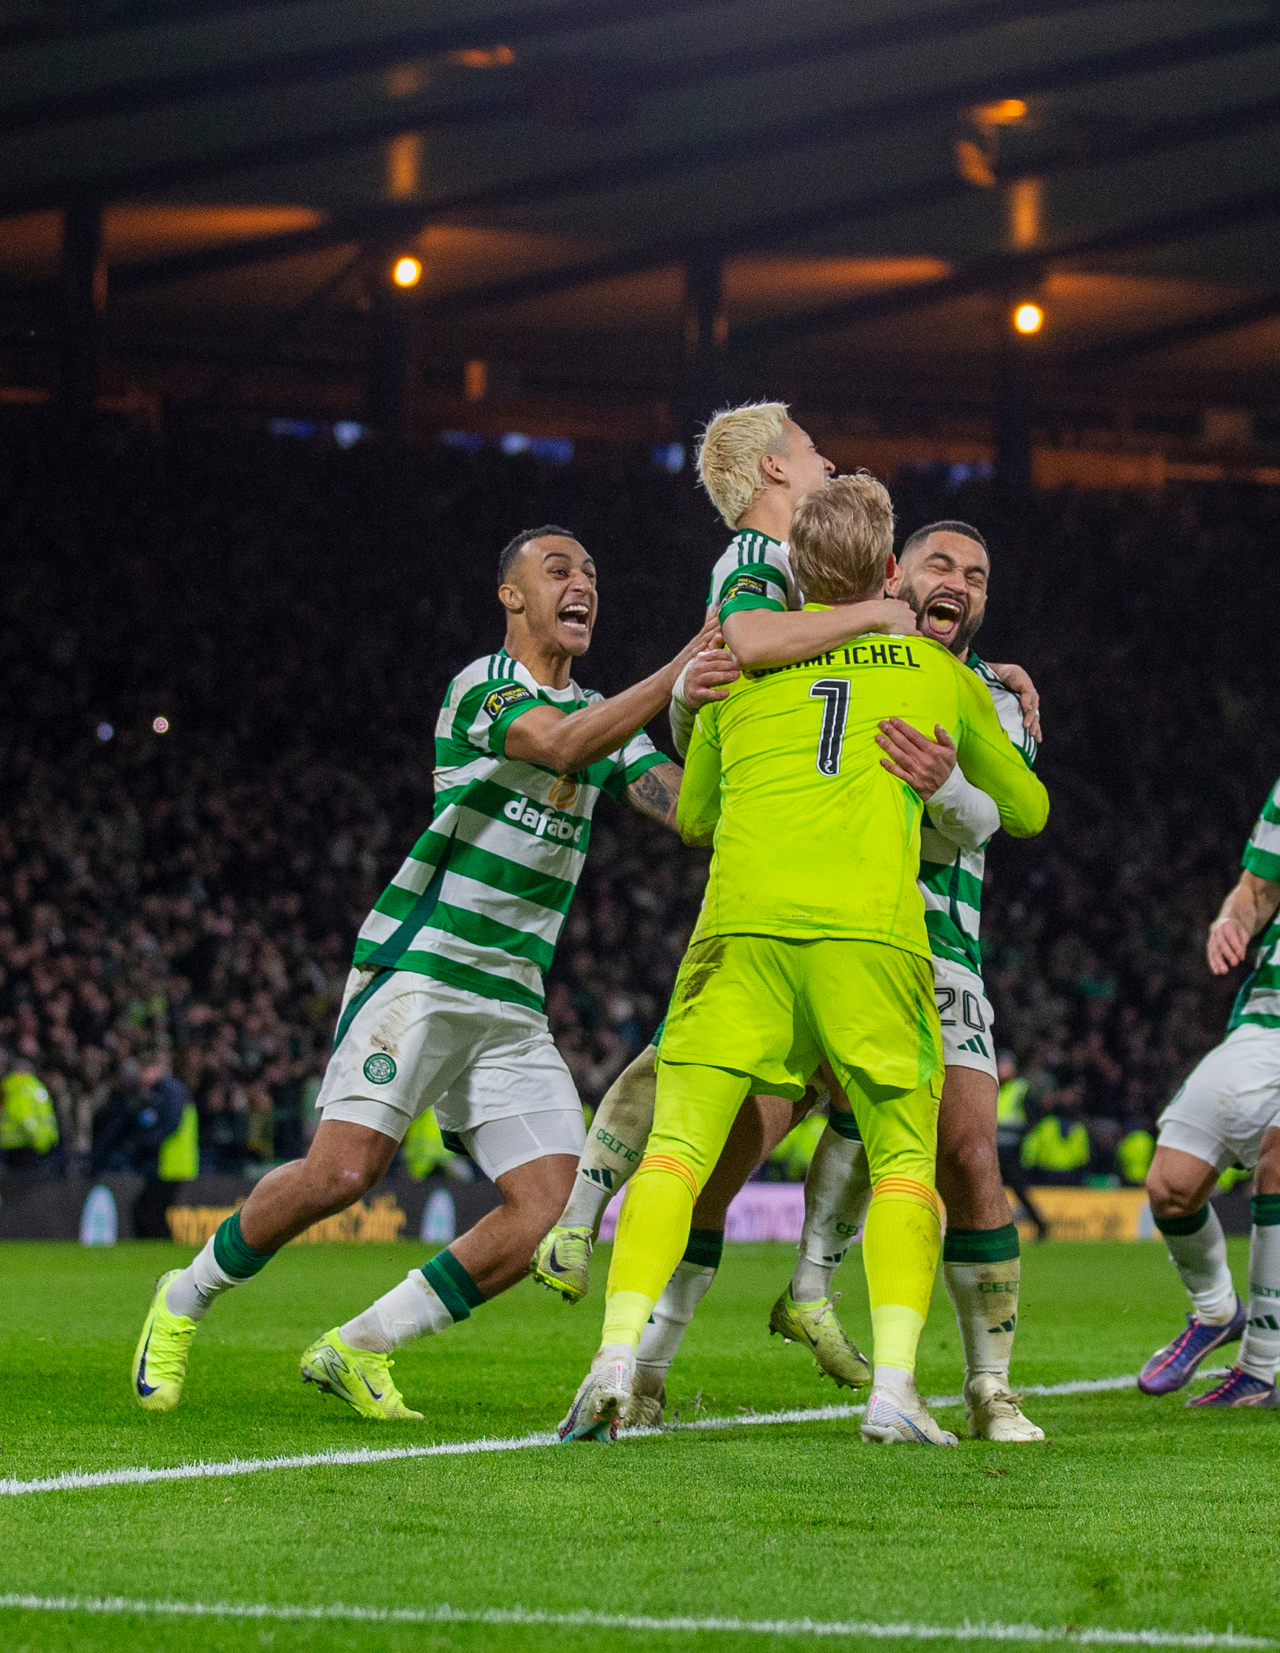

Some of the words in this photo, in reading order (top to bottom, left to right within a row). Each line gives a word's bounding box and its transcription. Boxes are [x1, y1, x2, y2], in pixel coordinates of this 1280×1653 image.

[809, 677, 851, 777] 1
[934, 987, 986, 1033] 20
[596, 1128, 639, 1162] CELTIC
[835, 1222, 862, 1236] CEL
